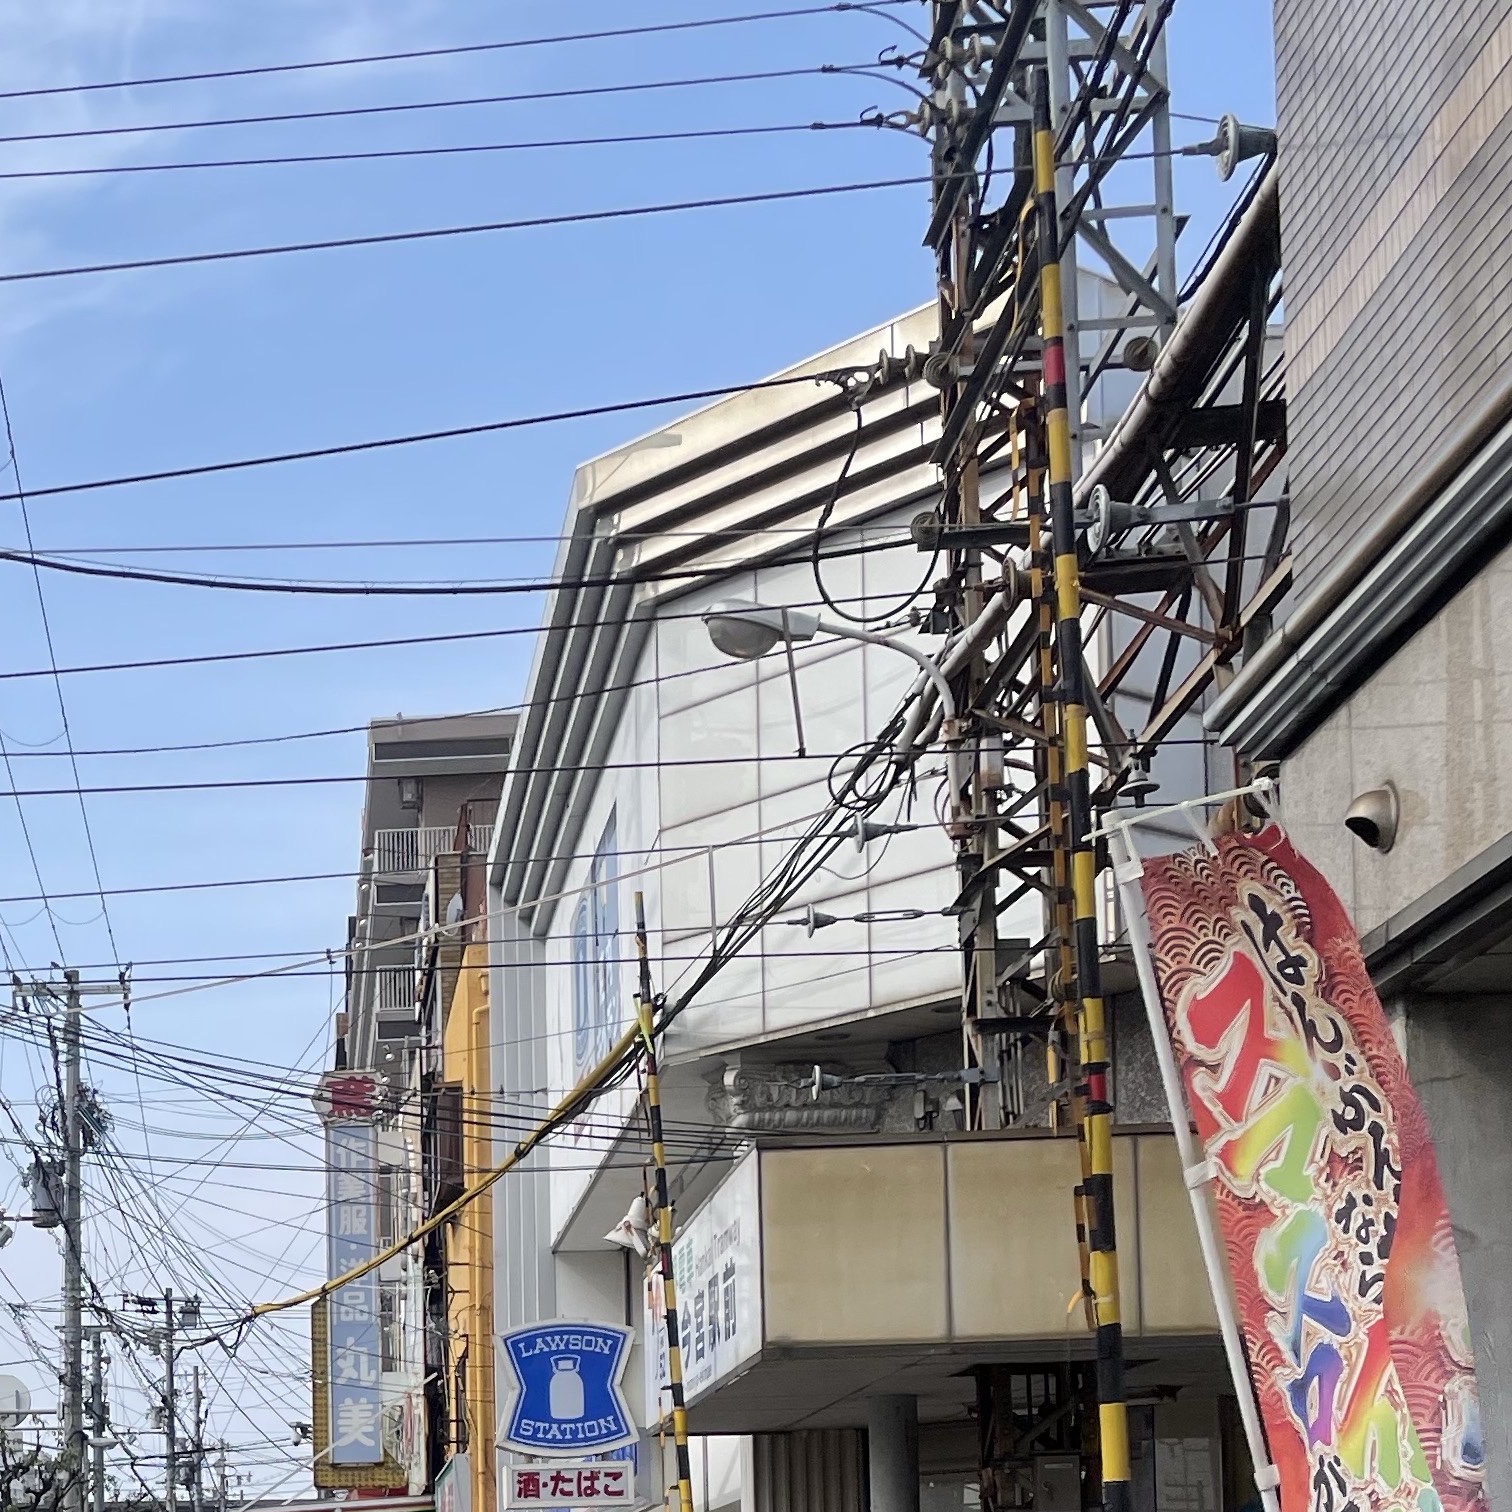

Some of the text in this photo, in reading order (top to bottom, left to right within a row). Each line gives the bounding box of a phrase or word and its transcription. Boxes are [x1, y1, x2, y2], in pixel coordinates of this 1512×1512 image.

[518, 1334, 613, 1359] LAWSON
[519, 1415, 618, 1440] STATION
[516, 1470, 626, 1499] 酒・たばこ
